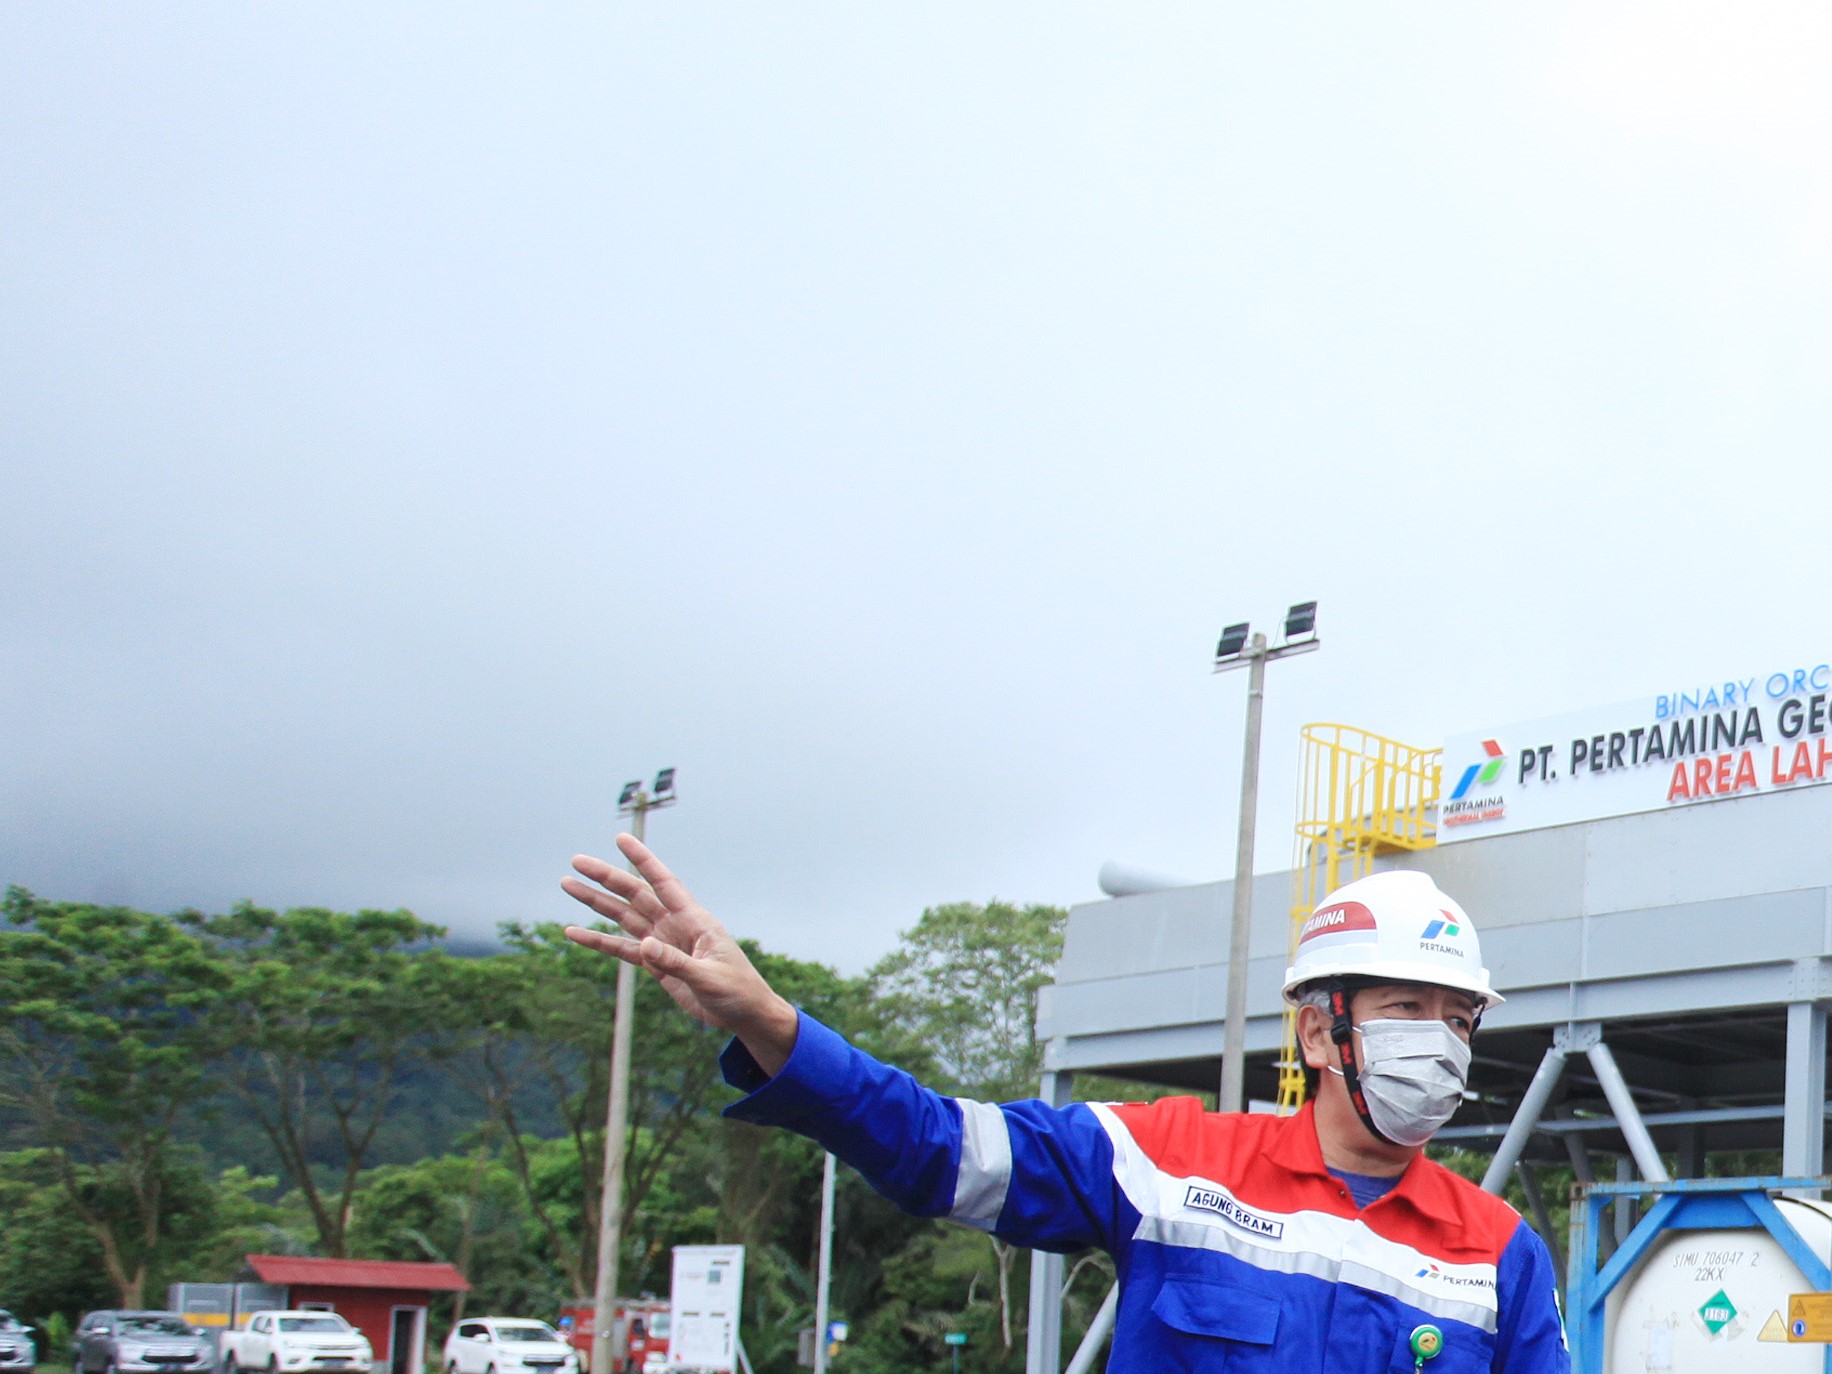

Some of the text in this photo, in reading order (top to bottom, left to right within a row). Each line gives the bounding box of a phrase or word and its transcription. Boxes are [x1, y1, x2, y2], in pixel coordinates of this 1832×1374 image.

[1655, 677, 1756, 720] BINARY
[1765, 664, 1831, 699] ORC
[1518, 744, 1557, 785] PT.
[1569, 706, 1764, 775] PERTAMINA
[1666, 750, 1758, 801] AREA
[1443, 796, 1504, 814] PERTAMINA
[1419, 942, 1465, 958] PERTAMINA
[1192, 1191, 1274, 1234] AGUNG BRAM
[1673, 1251, 1760, 1268] SIMU 706047 2
[1443, 1275, 1495, 1290] PERTAMIN
[1694, 1268, 1726, 1282] 22KX
